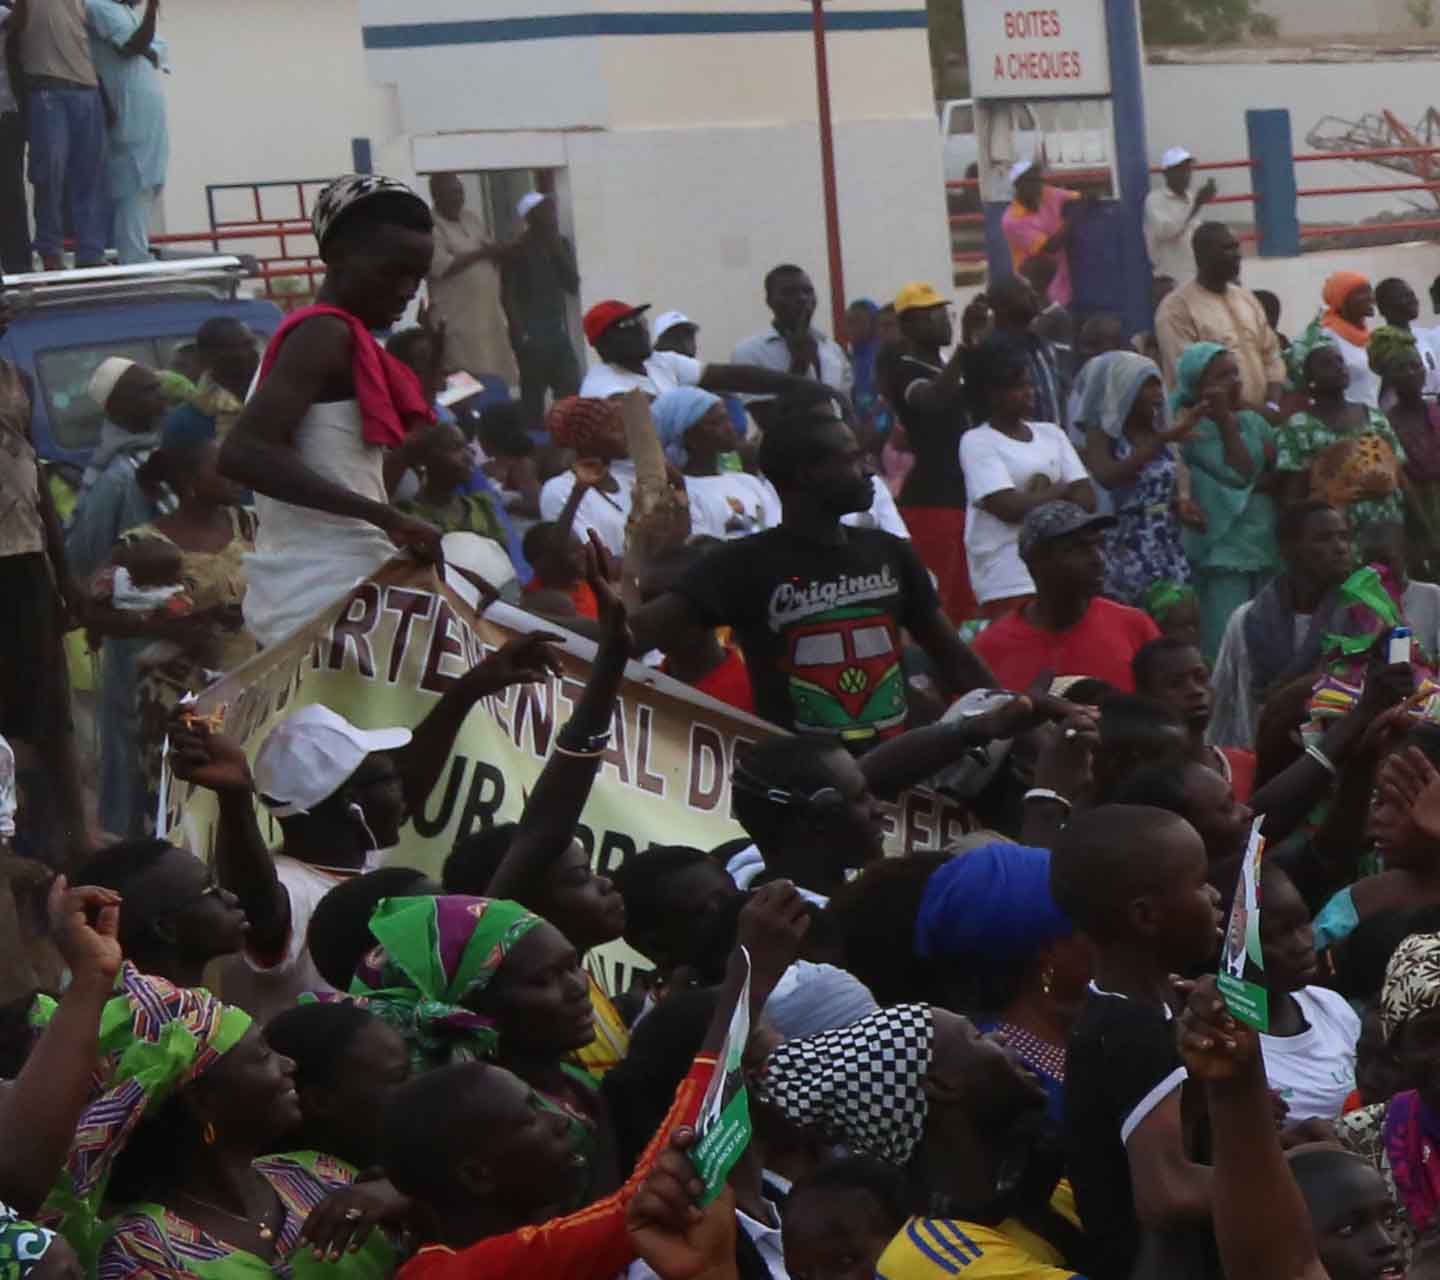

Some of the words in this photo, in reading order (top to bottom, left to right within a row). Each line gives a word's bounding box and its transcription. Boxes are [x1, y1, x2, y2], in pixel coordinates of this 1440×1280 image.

[1004, 10, 1061, 38] BOITES
[994, 56, 1007, 80] A
[1007, 51, 1081, 80] CHEQUES
[767, 564, 898, 622] Original
